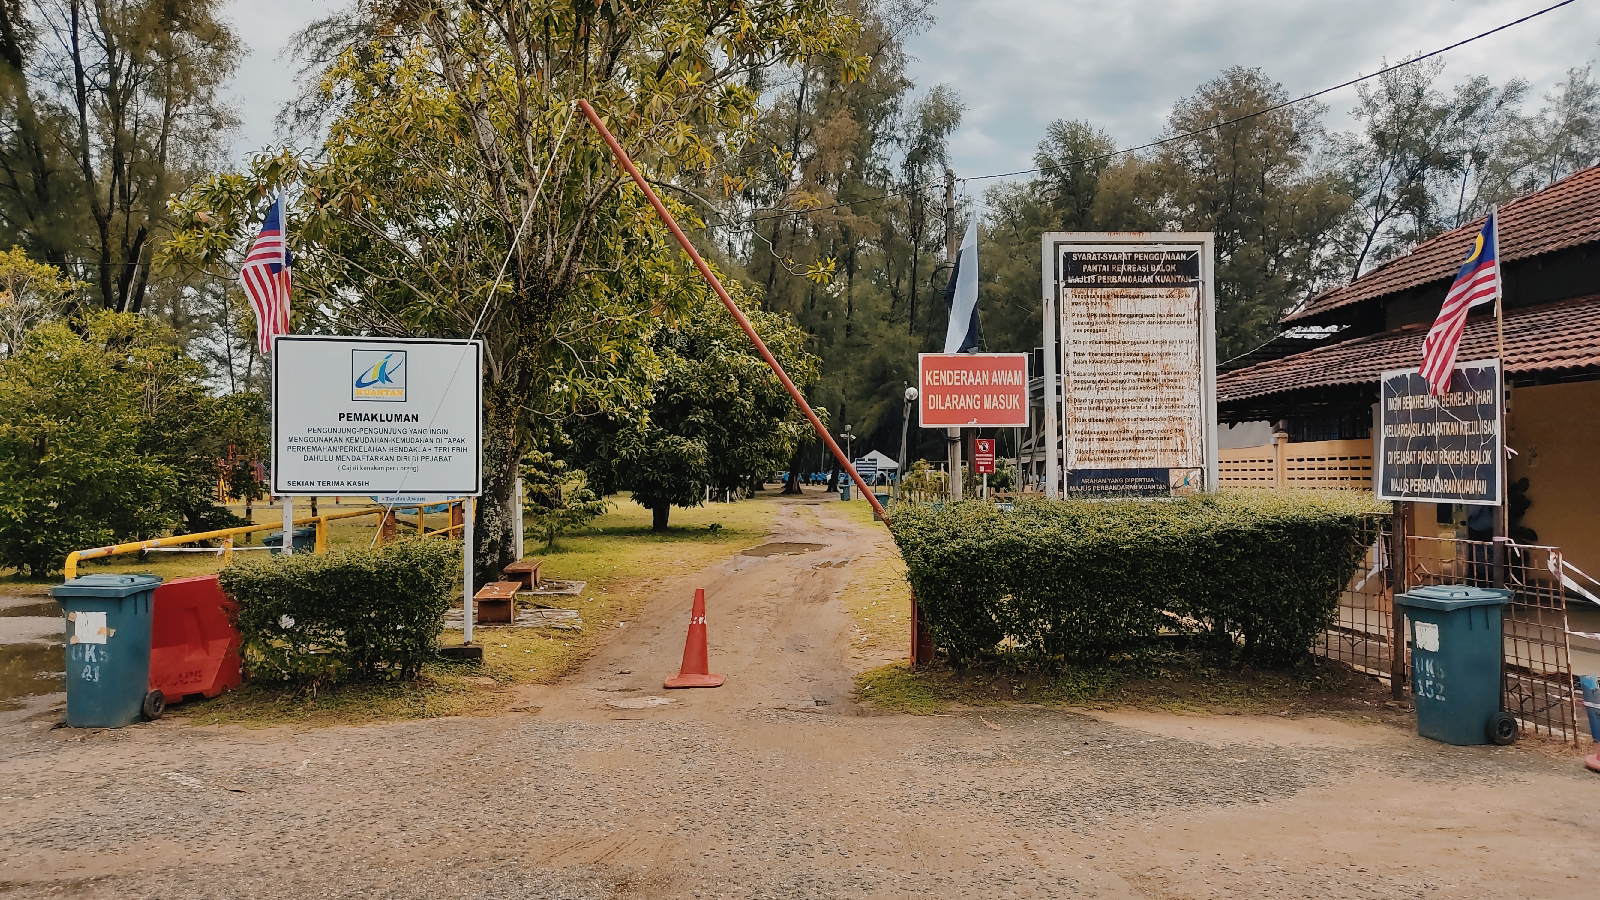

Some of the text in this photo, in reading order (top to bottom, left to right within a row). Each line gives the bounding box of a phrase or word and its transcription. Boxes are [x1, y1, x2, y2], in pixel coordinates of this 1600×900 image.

[1072, 253, 1132, 261] SYARAT-SYARAT
[1082, 264, 1176, 272] PANTAI REKREASI BALOK
[1068, 275, 1192, 284] MAJLIS PERBANDARAN KUANTAN
[926, 370, 1022, 386] KENDERAAN AWAM
[928, 394, 1020, 410] DILARANG MASUK
[1388, 396, 1401, 411] INGIN
[1442, 391, 1474, 407] BERKELAH
[1478, 389, 1492, 404] HARI
[338, 412, 419, 422] PEMAKLUMAN
[1384, 420, 1496, 438] KELUARGA SILA DAPATKAN KELULUSAN
[1388, 450, 1492, 465] DI PEJABAT PUSAT REKREASI BALOK
[1391, 478, 1487, 494] MAJLIS PERBANDARAN KUANTAN
